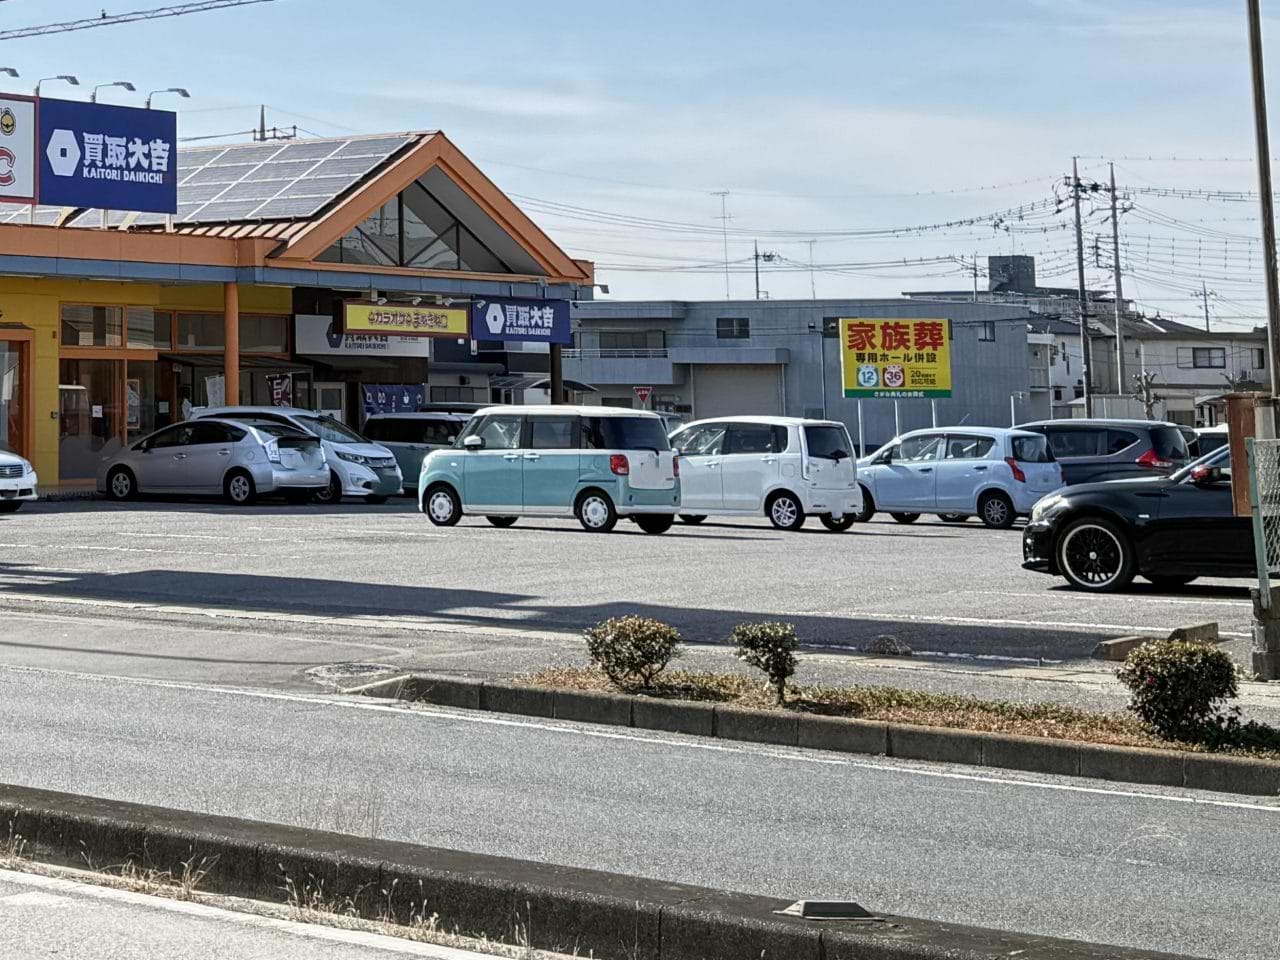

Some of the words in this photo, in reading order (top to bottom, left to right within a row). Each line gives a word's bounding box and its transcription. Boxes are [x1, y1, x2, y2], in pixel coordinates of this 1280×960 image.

[82, 132, 170, 172] 買取大吉
[82, 166, 121, 181] KAITORI
[123, 169, 163, 184] DAIKICHI
[505, 304, 554, 328] 買取大吉
[847, 321, 944, 351] 家族葬
[856, 352, 937, 363] 専用ホール併設
